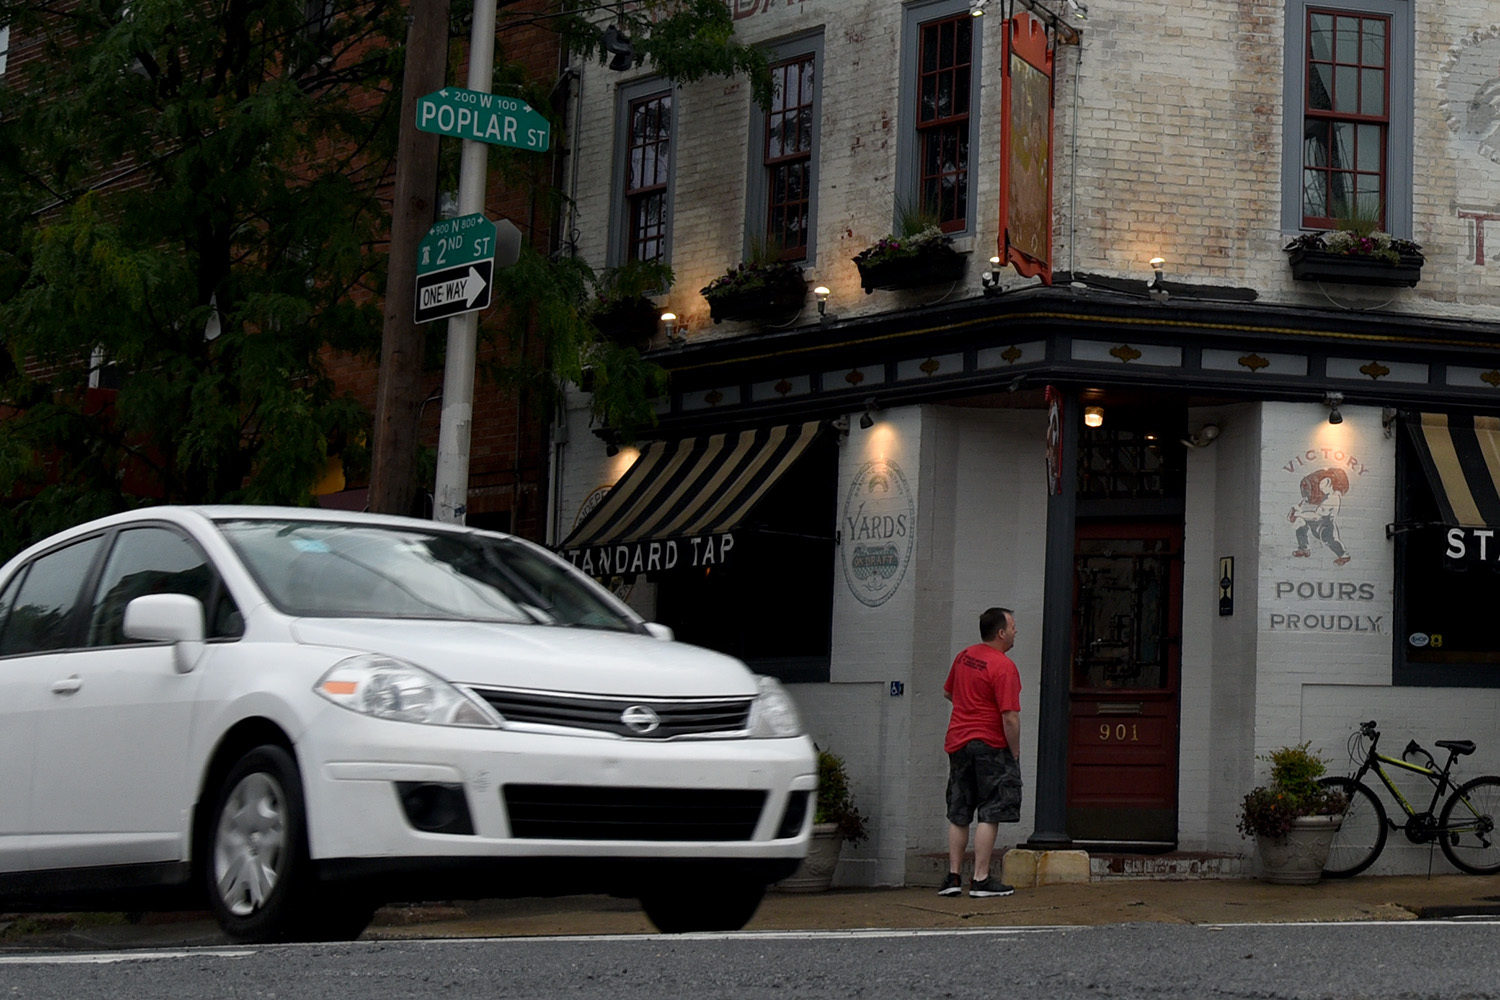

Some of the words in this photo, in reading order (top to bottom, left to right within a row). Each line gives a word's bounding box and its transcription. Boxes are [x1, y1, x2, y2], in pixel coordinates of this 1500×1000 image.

[454, 90, 477, 104] 200
[480, 94, 493, 109] W
[497, 99, 518, 112] 100
[421, 101, 518, 143] POPLAR
[527, 128, 546, 148] ST
[435, 223, 449, 236] 900
[451, 219, 460, 234] N
[461, 217, 476, 229] 800
[436, 234, 463, 265] 2ND
[473, 237, 491, 257] ST
[423, 285, 443, 306] ONE
[446, 279, 468, 301] WAY
[1282, 448, 1370, 477] VICTORY
[847, 500, 908, 542] YARDS
[690, 533, 735, 567] TAP
[1275, 581, 1376, 601] POURS
[1269, 613, 1383, 632] PROUDLY
[1099, 723, 1139, 741] 901
